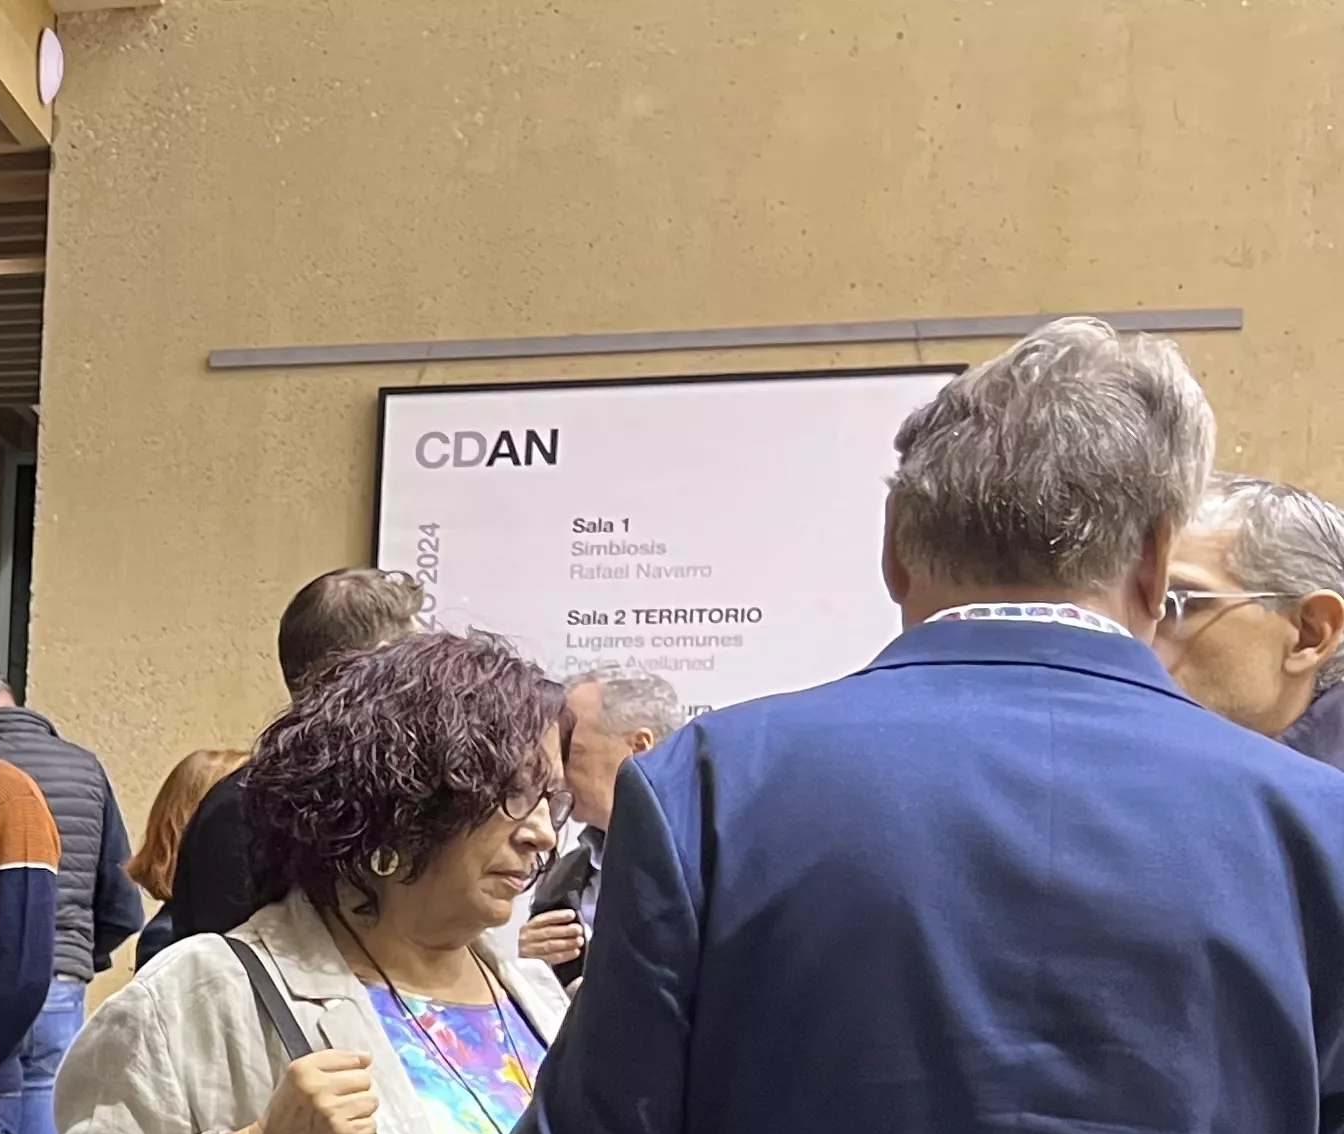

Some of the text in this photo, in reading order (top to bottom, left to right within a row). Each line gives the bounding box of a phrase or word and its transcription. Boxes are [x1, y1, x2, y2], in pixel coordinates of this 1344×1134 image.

[415, 428, 559, 469] CDAN
[572, 517, 630, 533] Sala 1
[416, 522, 440, 585] 2024
[571, 540, 667, 557] Simbiosis
[569, 562, 712, 580] Rafael Navarro
[567, 607, 763, 626] Sala 2 TERRITORIO
[566, 633, 743, 651] Lugares comunes
